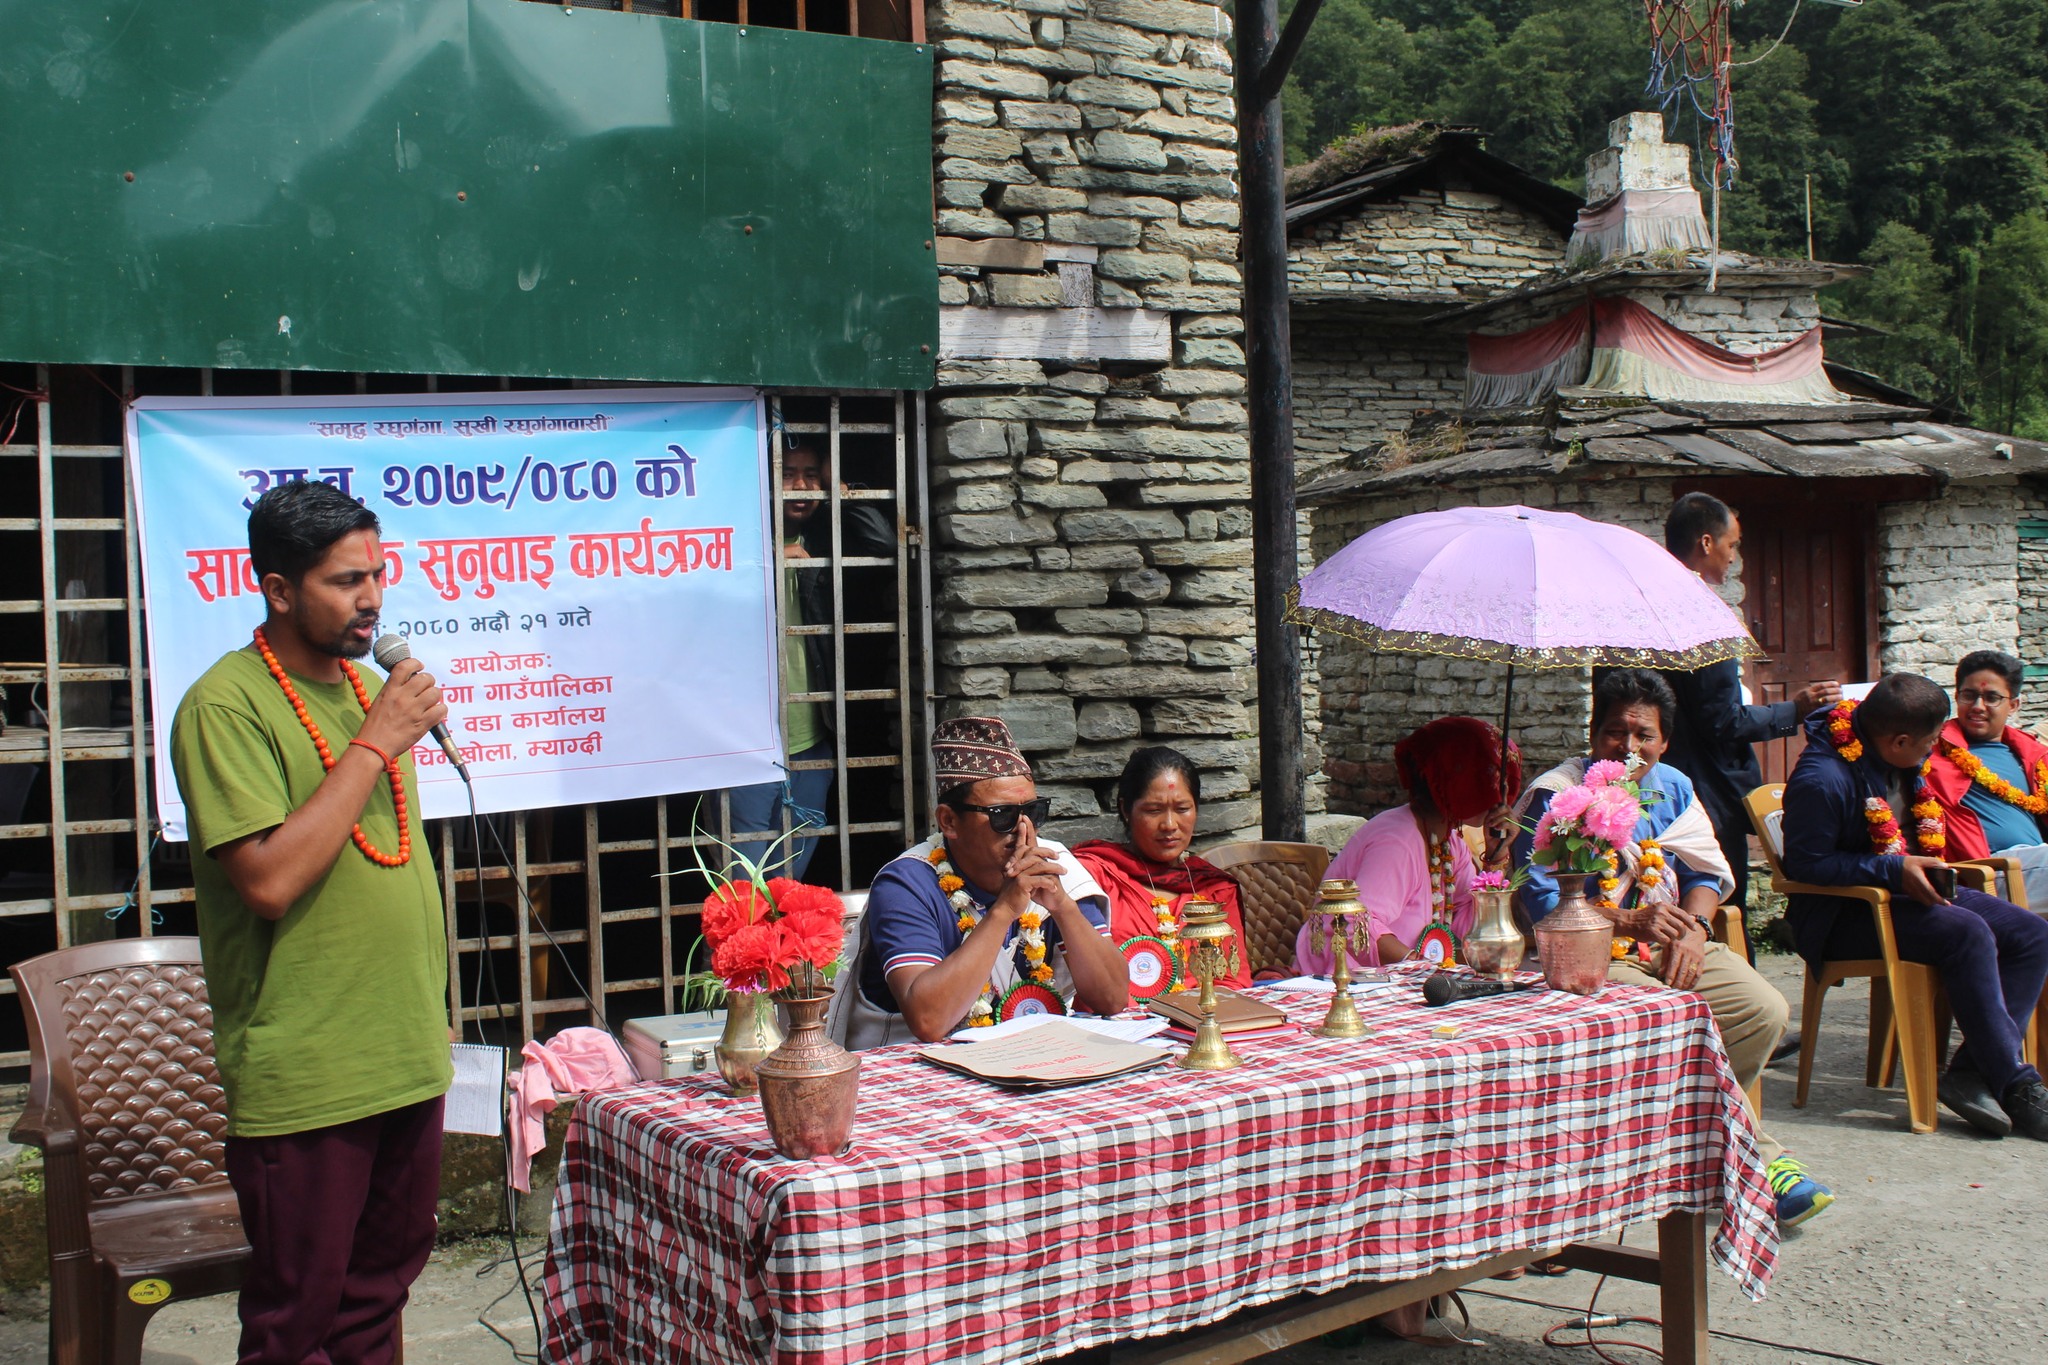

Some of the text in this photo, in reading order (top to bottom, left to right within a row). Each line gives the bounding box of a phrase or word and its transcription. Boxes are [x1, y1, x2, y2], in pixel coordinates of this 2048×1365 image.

[453, 415, 497, 437] सुखी
[383, 456, 617, 510] २०७९/०८०
[635, 444, 697, 498] को
[417, 535, 556, 600] सुनुवाइ
[568, 517, 734, 579] कार्यक्रम
[398, 618, 460, 640] २०८०
[469, 609, 511, 634] भदौ
[520, 613, 548, 633] २१
[556, 606, 592, 628] गते
[449, 650, 553, 675] आयोजक:
[483, 673, 613, 701] गाउँपालिका
[462, 714, 502, 733] वडा
[510, 706, 607, 730] कार्यालय
[525, 730, 603, 756] म्याग्दी
